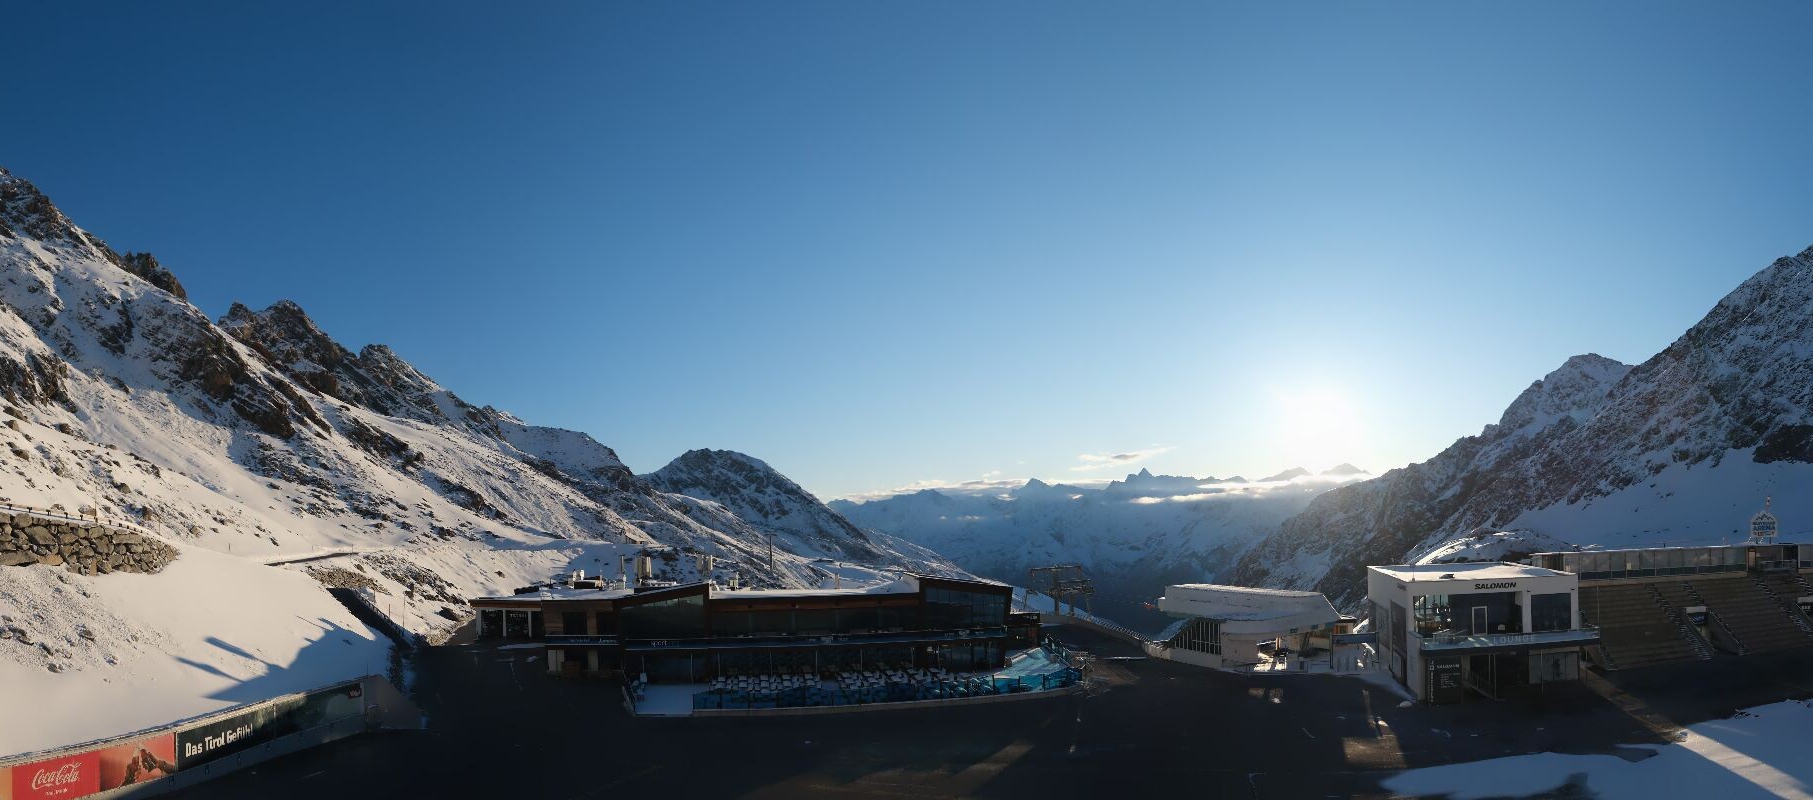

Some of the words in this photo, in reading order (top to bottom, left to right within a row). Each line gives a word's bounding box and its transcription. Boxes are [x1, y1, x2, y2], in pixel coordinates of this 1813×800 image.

[1474, 582, 1517, 590] SALOMON
[185, 742, 203, 758] Das
[204, 732, 225, 751] Tirol
